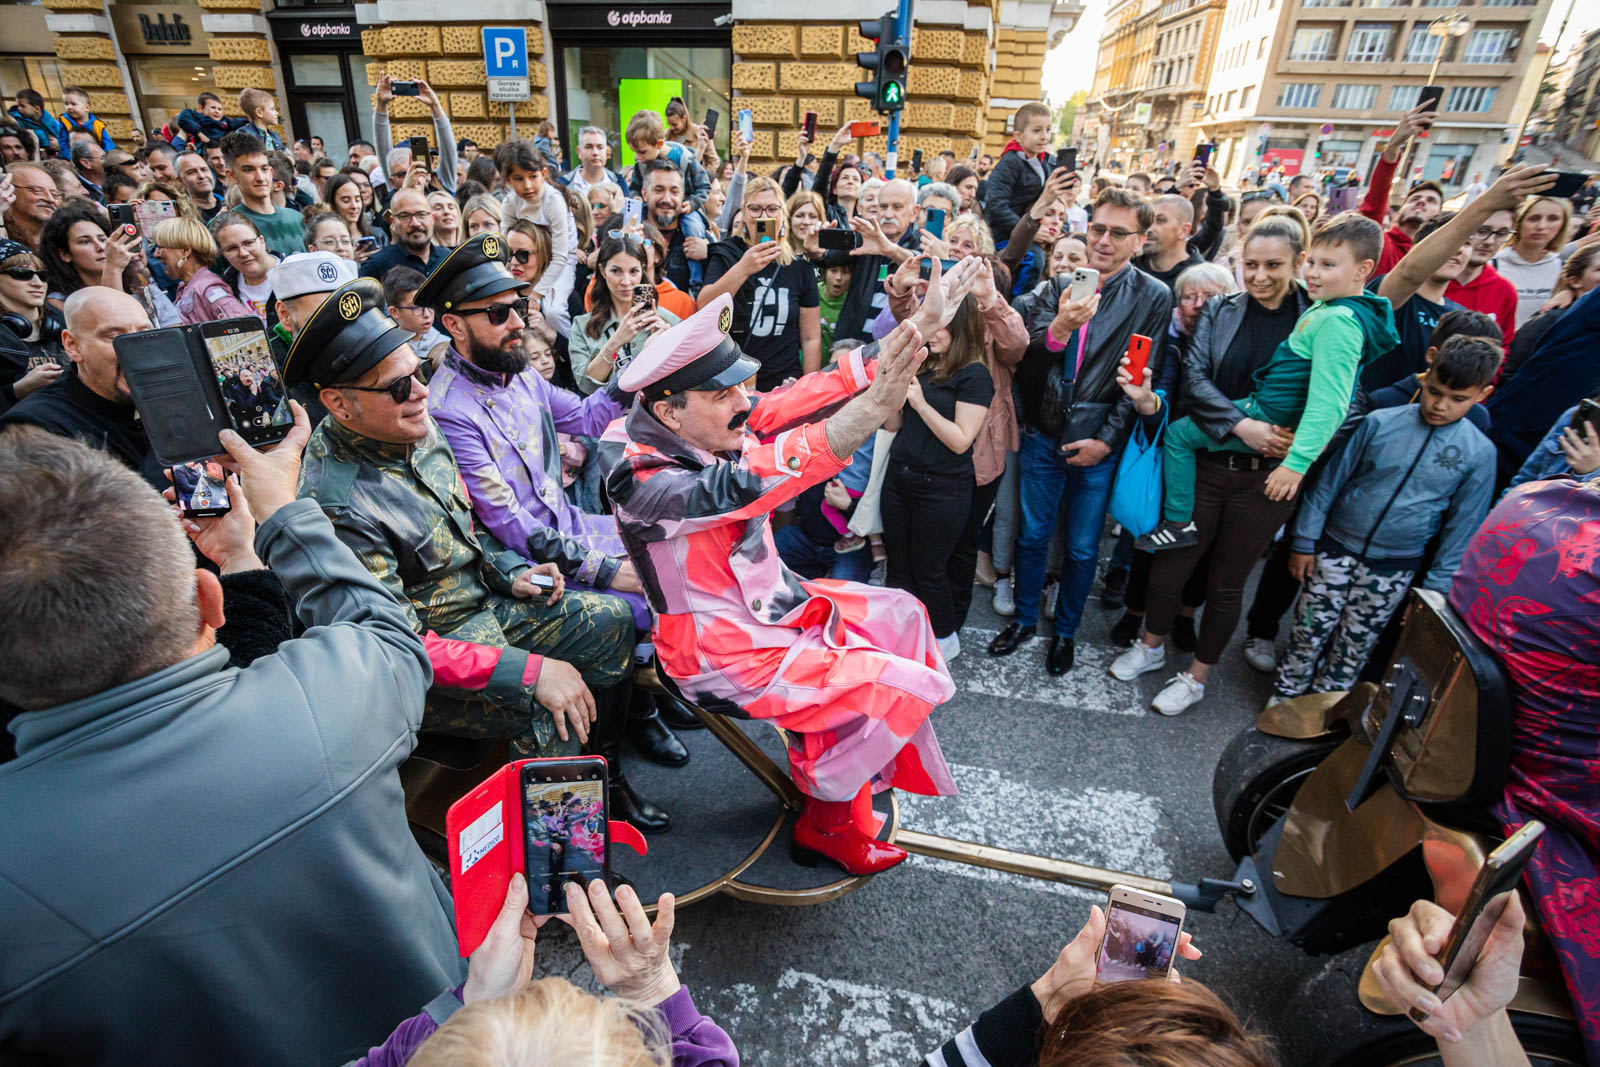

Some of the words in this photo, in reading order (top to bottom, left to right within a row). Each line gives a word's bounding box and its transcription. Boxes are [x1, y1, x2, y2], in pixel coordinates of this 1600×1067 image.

[621, 10, 672, 27] otpbanka
[312, 22, 350, 37] otpbanka
[494, 37, 515, 68] P
[479, 835, 500, 855] MEDICO
